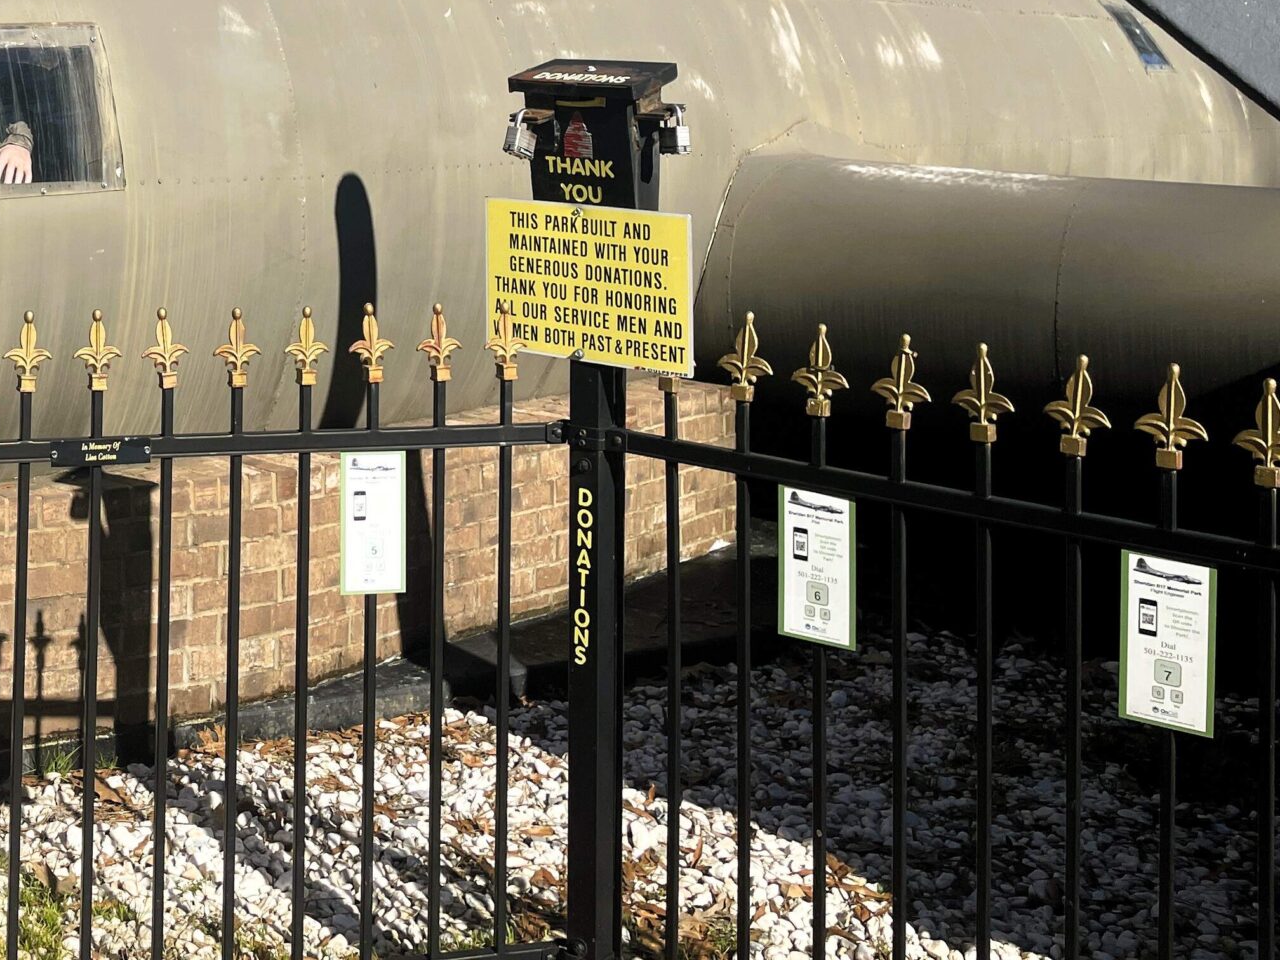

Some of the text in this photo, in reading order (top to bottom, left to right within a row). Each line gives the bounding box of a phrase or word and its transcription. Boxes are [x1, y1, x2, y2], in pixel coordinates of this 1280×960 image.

[533, 71, 631, 84] DONATIONS
[545, 156, 615, 178] THANK
[560, 183, 602, 204] YOU
[510, 211, 651, 240] THIS PARK BUILT AND
[509, 234, 669, 267] MAINTAINED WITH YOUR
[509, 256, 667, 290] GENEROUS DONATIONS.
[495, 276, 677, 316] THANK YOU FOR HONORING
[495, 298, 682, 340] AL OUR SERVICE MEN AND
[493, 319, 686, 364] WMEN BOTH PAST & PRESENT
[81, 441, 121, 452] In Memory Of
[98, 452, 117, 461] Cotton
[370, 545, 378, 556] 5
[573, 487, 594, 666] DONATIONS
[811, 564, 824, 573] Dial
[814, 591, 821, 601] 6
[1161, 640, 1176, 651] Dial
[1143, 647, 1194, 664] 501-222-1135
[1164, 670, 1172, 682] 7
